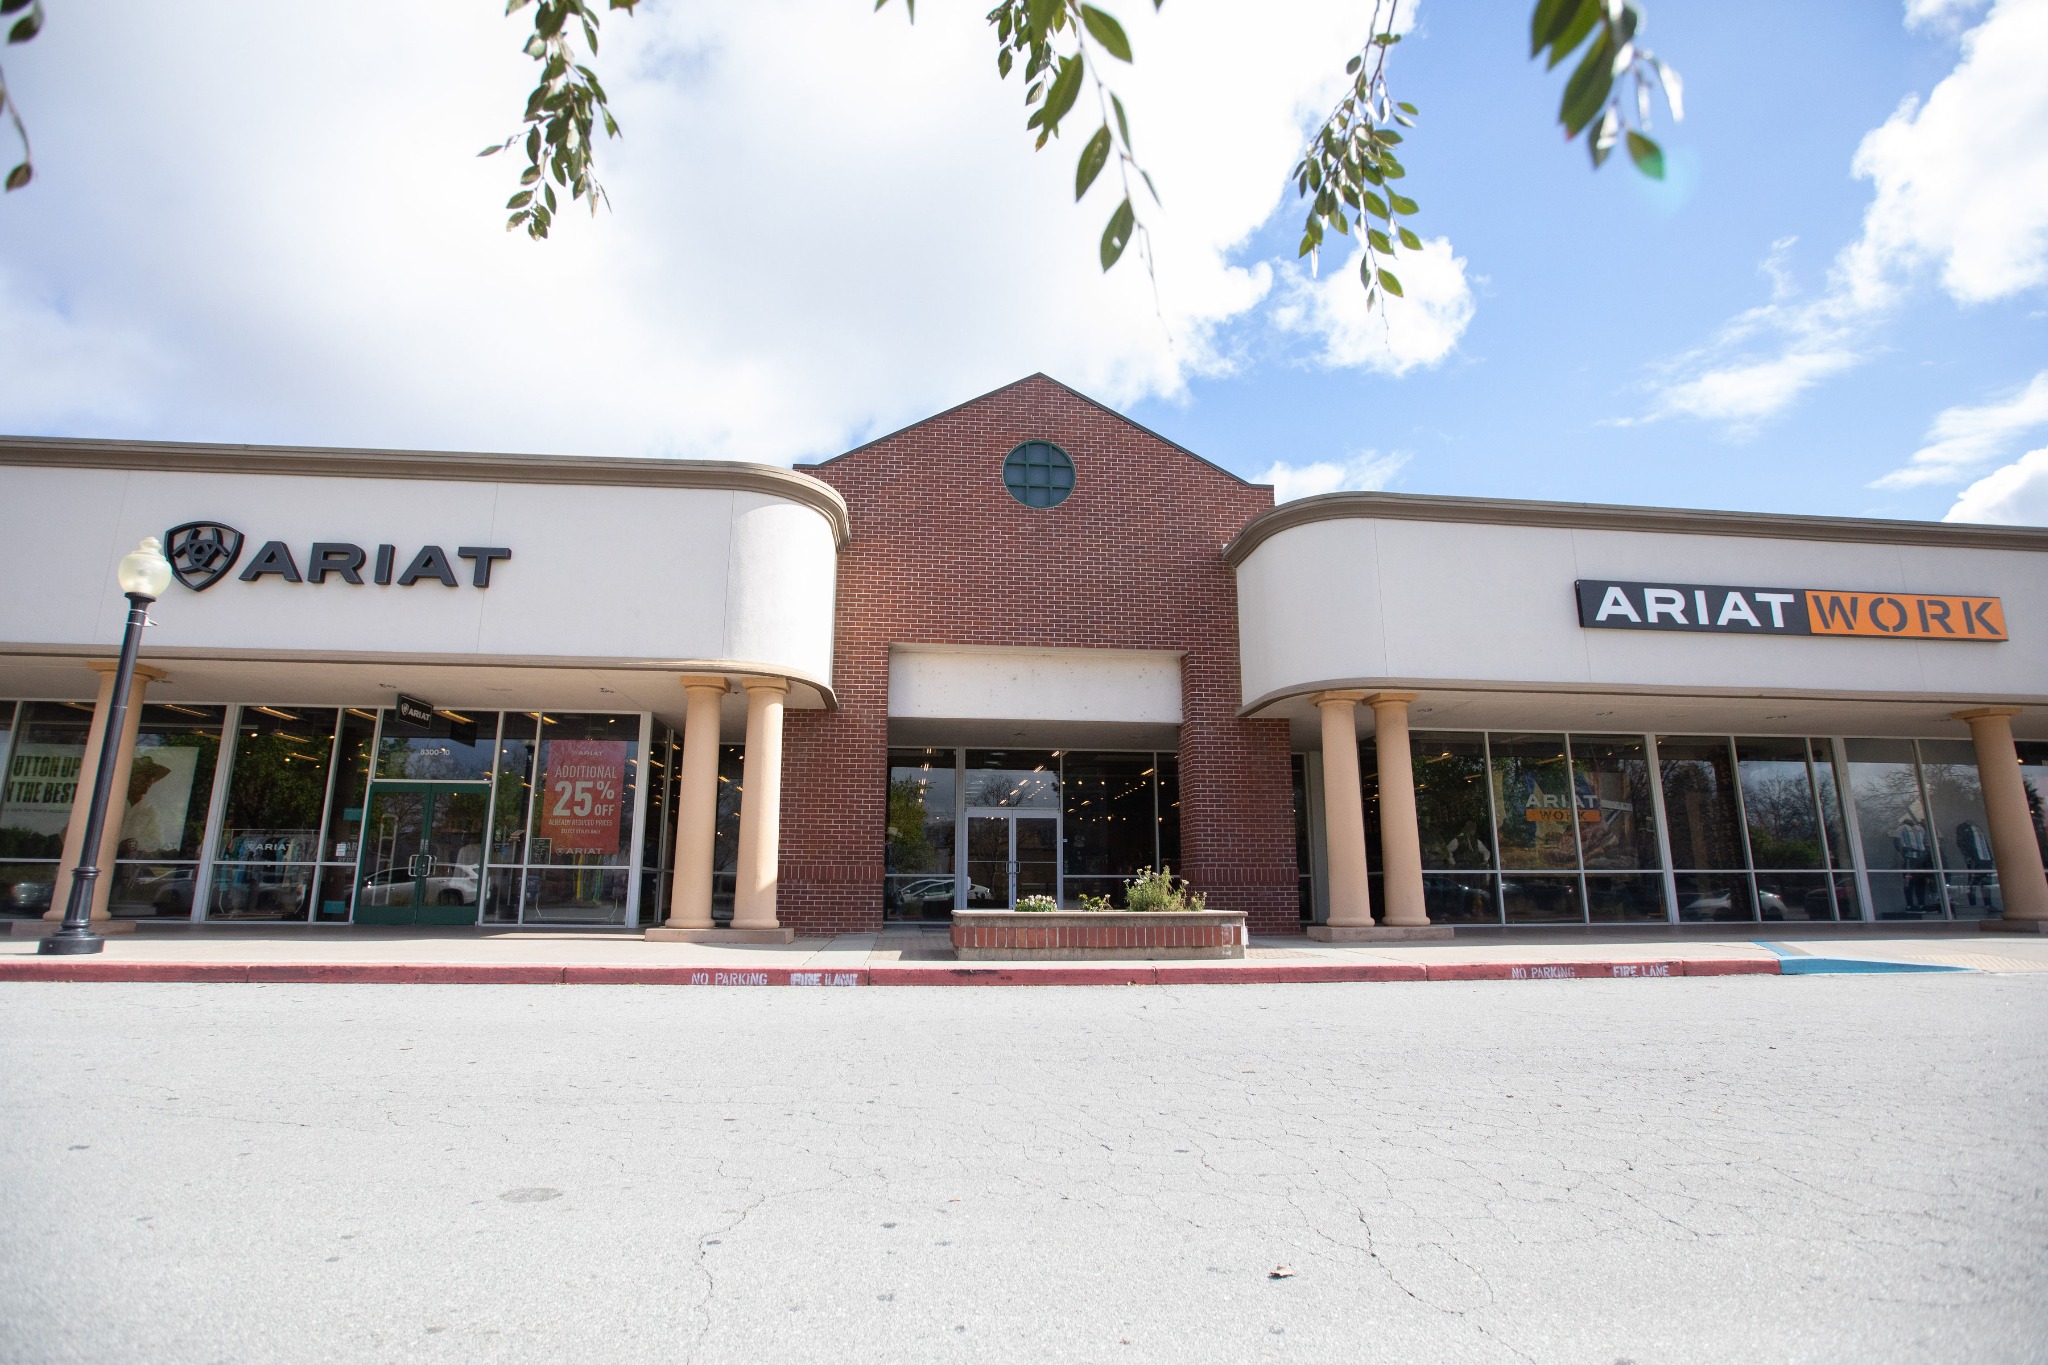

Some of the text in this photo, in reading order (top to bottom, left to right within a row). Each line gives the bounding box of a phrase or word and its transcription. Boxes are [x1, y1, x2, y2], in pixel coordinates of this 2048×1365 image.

[239, 541, 512, 589] ARIAT
[1595, 586, 2003, 635] ARIAT WORK
[408, 708, 431, 721] ARIAT
[420, 748, 450, 756] 8300-10
[13, 756, 82, 777] UTTON UP
[555, 765, 617, 778] ADDITIONAL
[16, 782, 42, 803] THE
[1526, 794, 1597, 809] ARIAT
[594, 804, 615, 816] OFF
[572, 819, 594, 827] REDUCED
[595, 819, 613, 827] PRICES
[565, 847, 603, 855] ARIAT
[1511, 966, 1575, 978] NO PARKING
[1613, 965, 1669, 977] FIRE LANE
[691, 972, 768, 986] NO PARKING
[790, 973, 821, 986] FIRE
